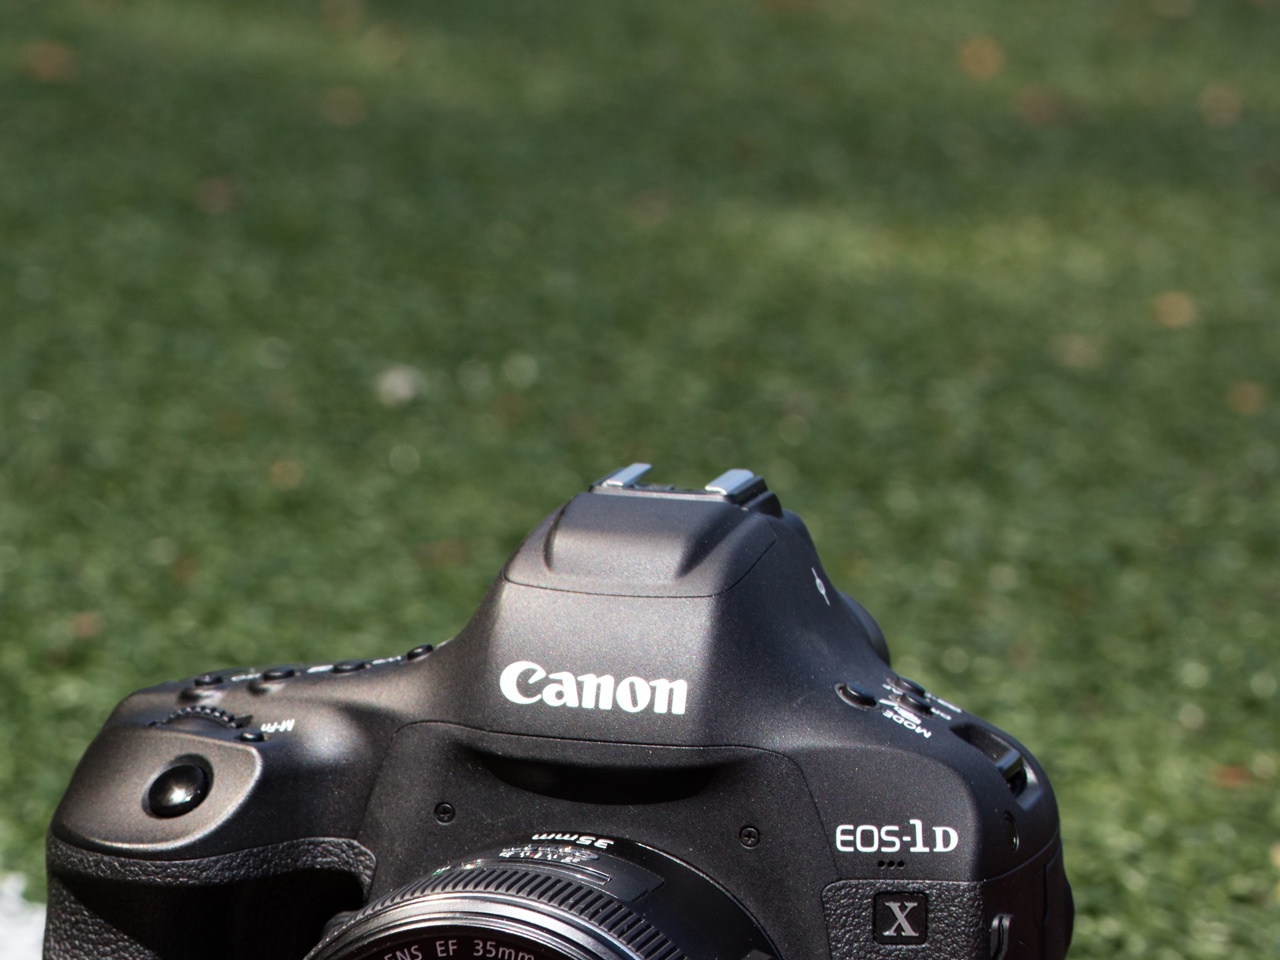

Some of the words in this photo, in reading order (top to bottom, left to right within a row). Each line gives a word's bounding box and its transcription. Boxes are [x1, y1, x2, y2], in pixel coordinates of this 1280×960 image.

[499, 660, 688, 715] Canon
[882, 709, 932, 739] MODE
[531, 833, 615, 849] 35mm
[882, 901, 920, 937] X
[435, 939, 459, 958] EF
